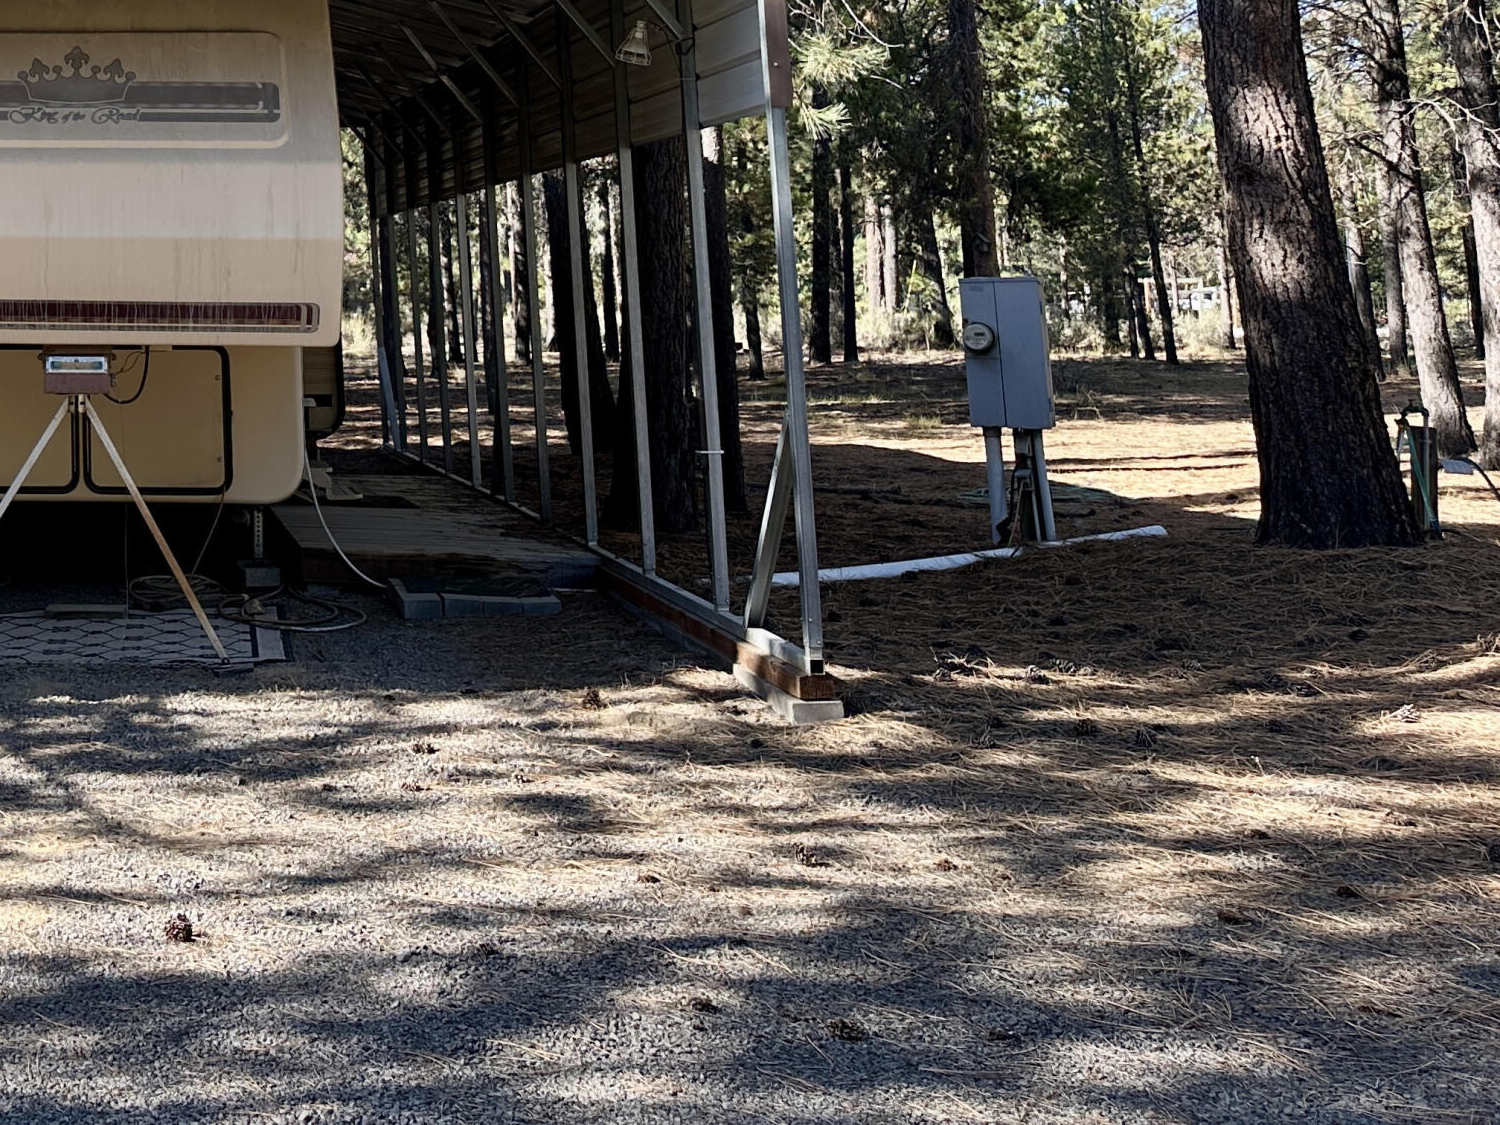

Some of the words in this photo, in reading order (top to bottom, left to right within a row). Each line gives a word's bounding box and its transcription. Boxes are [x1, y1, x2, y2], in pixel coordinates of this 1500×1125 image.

[9, 106, 59, 124] King
[61, 111, 74, 123] of
[91, 106, 140, 124] Road
